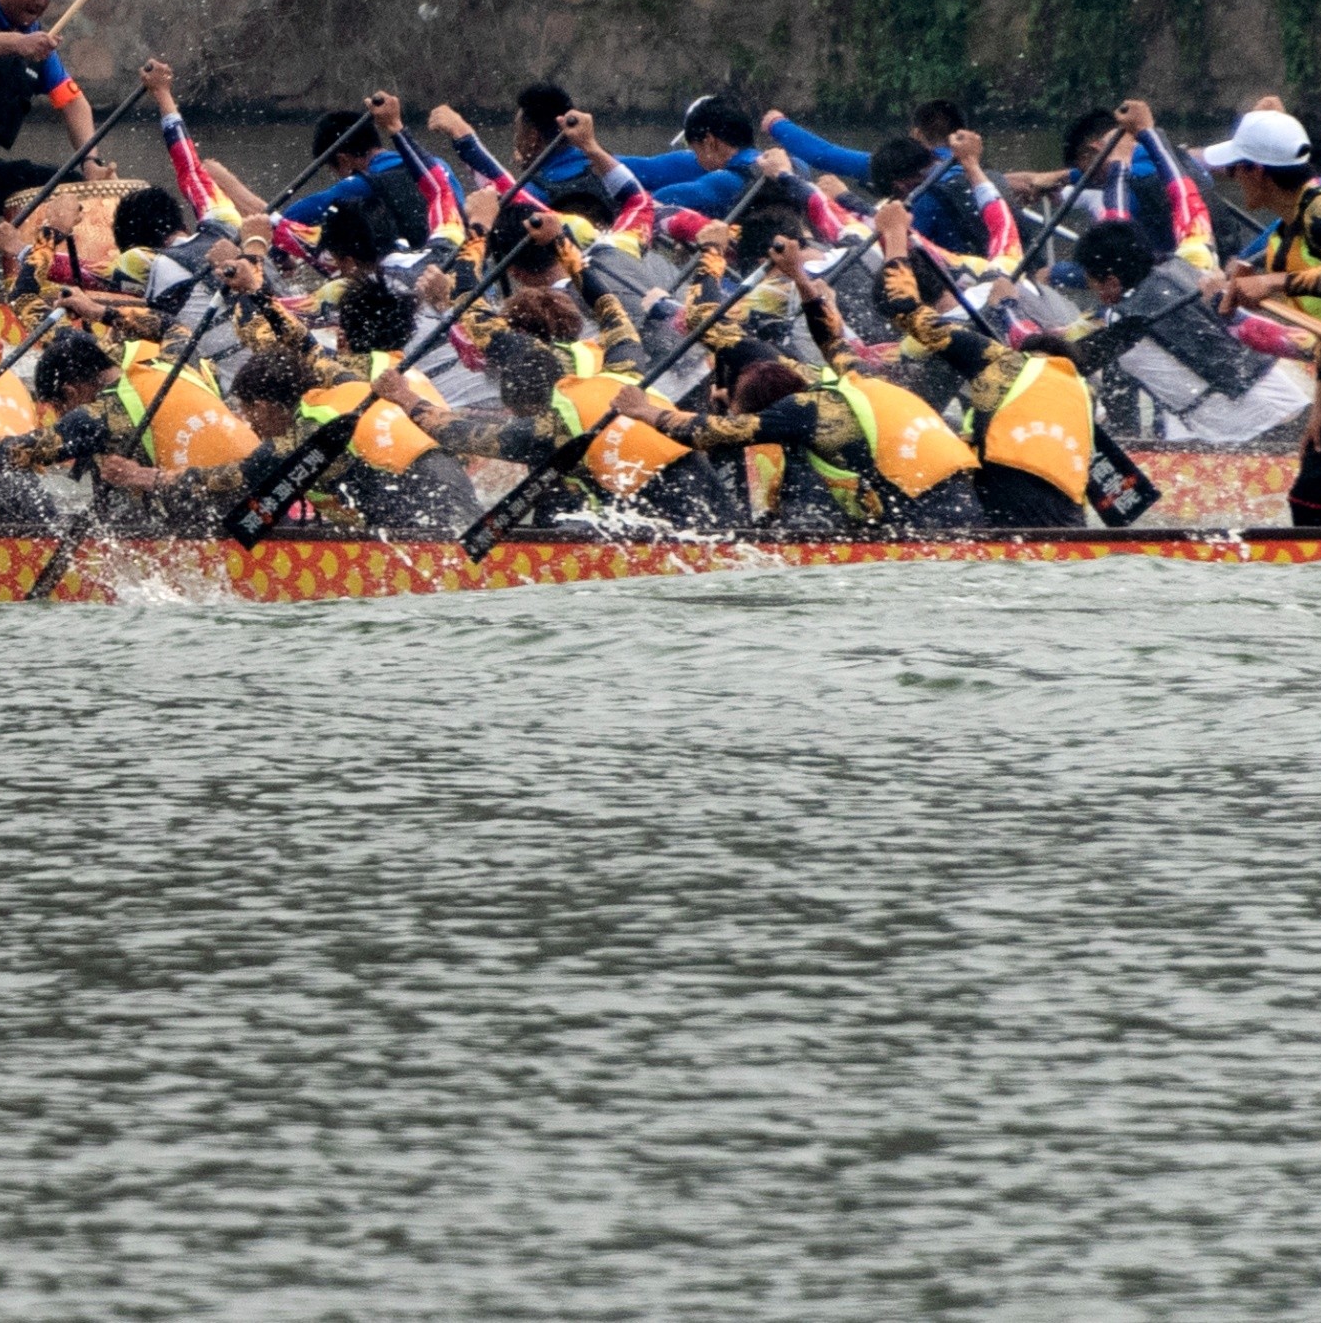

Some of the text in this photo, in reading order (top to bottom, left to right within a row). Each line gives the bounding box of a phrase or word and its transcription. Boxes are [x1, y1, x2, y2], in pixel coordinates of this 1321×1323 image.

[239, 448, 326, 534] 武汉商学院
